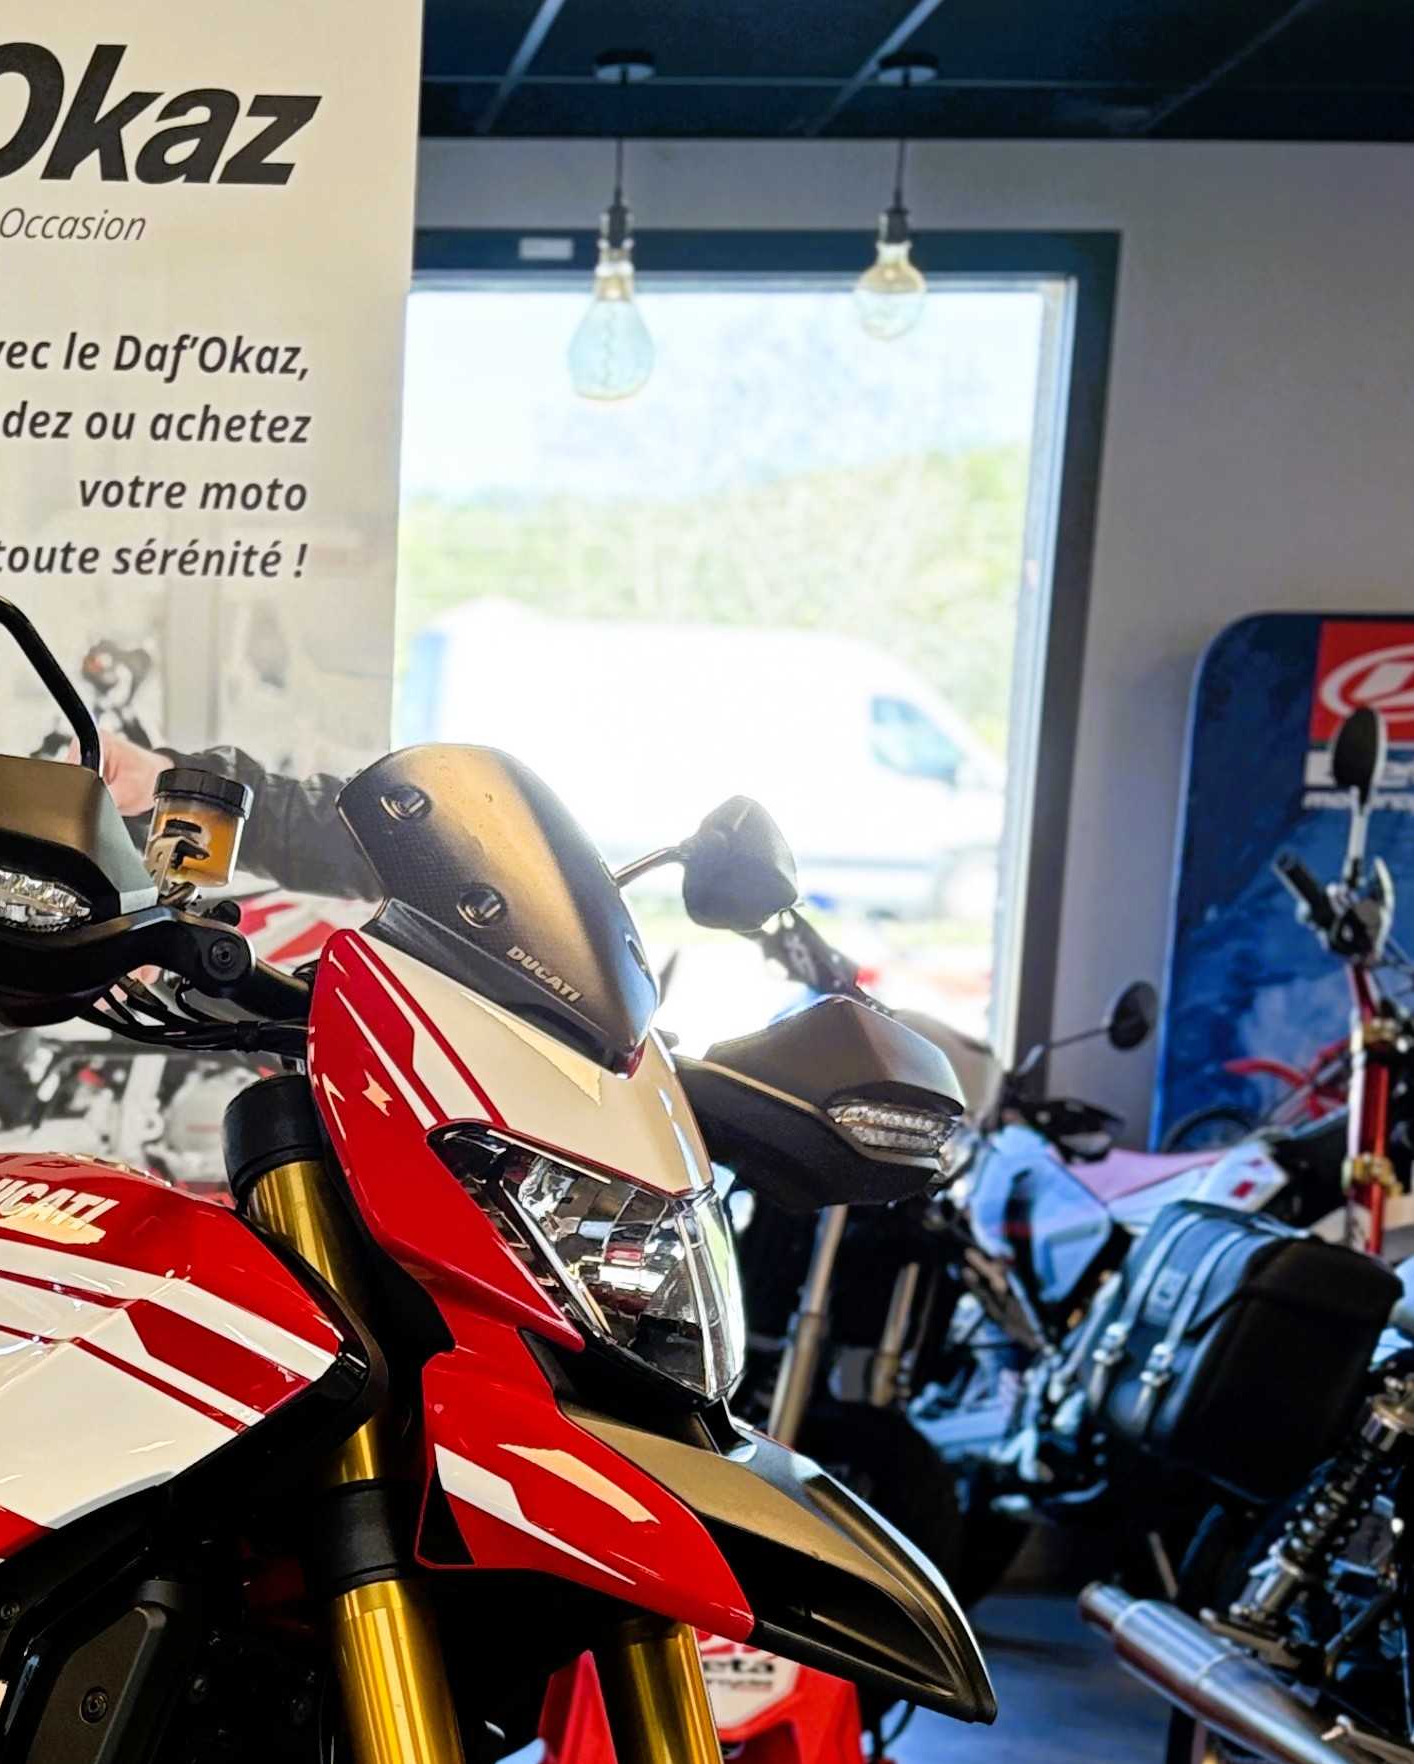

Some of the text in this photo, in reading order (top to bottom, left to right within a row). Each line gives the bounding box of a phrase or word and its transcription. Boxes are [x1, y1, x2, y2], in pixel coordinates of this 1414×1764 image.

[0, 207, 146, 241] Occasion
[65, 332, 100, 371] le
[115, 334, 310, 382] Daf'Okaz,
[86, 412, 135, 440] ou
[151, 404, 311, 443] achetez
[81, 477, 307, 511] votre moto
[112, 537, 281, 577] sérénité
[294, 543, 308, 577] !
[506, 946, 582, 1002] DUCATI
